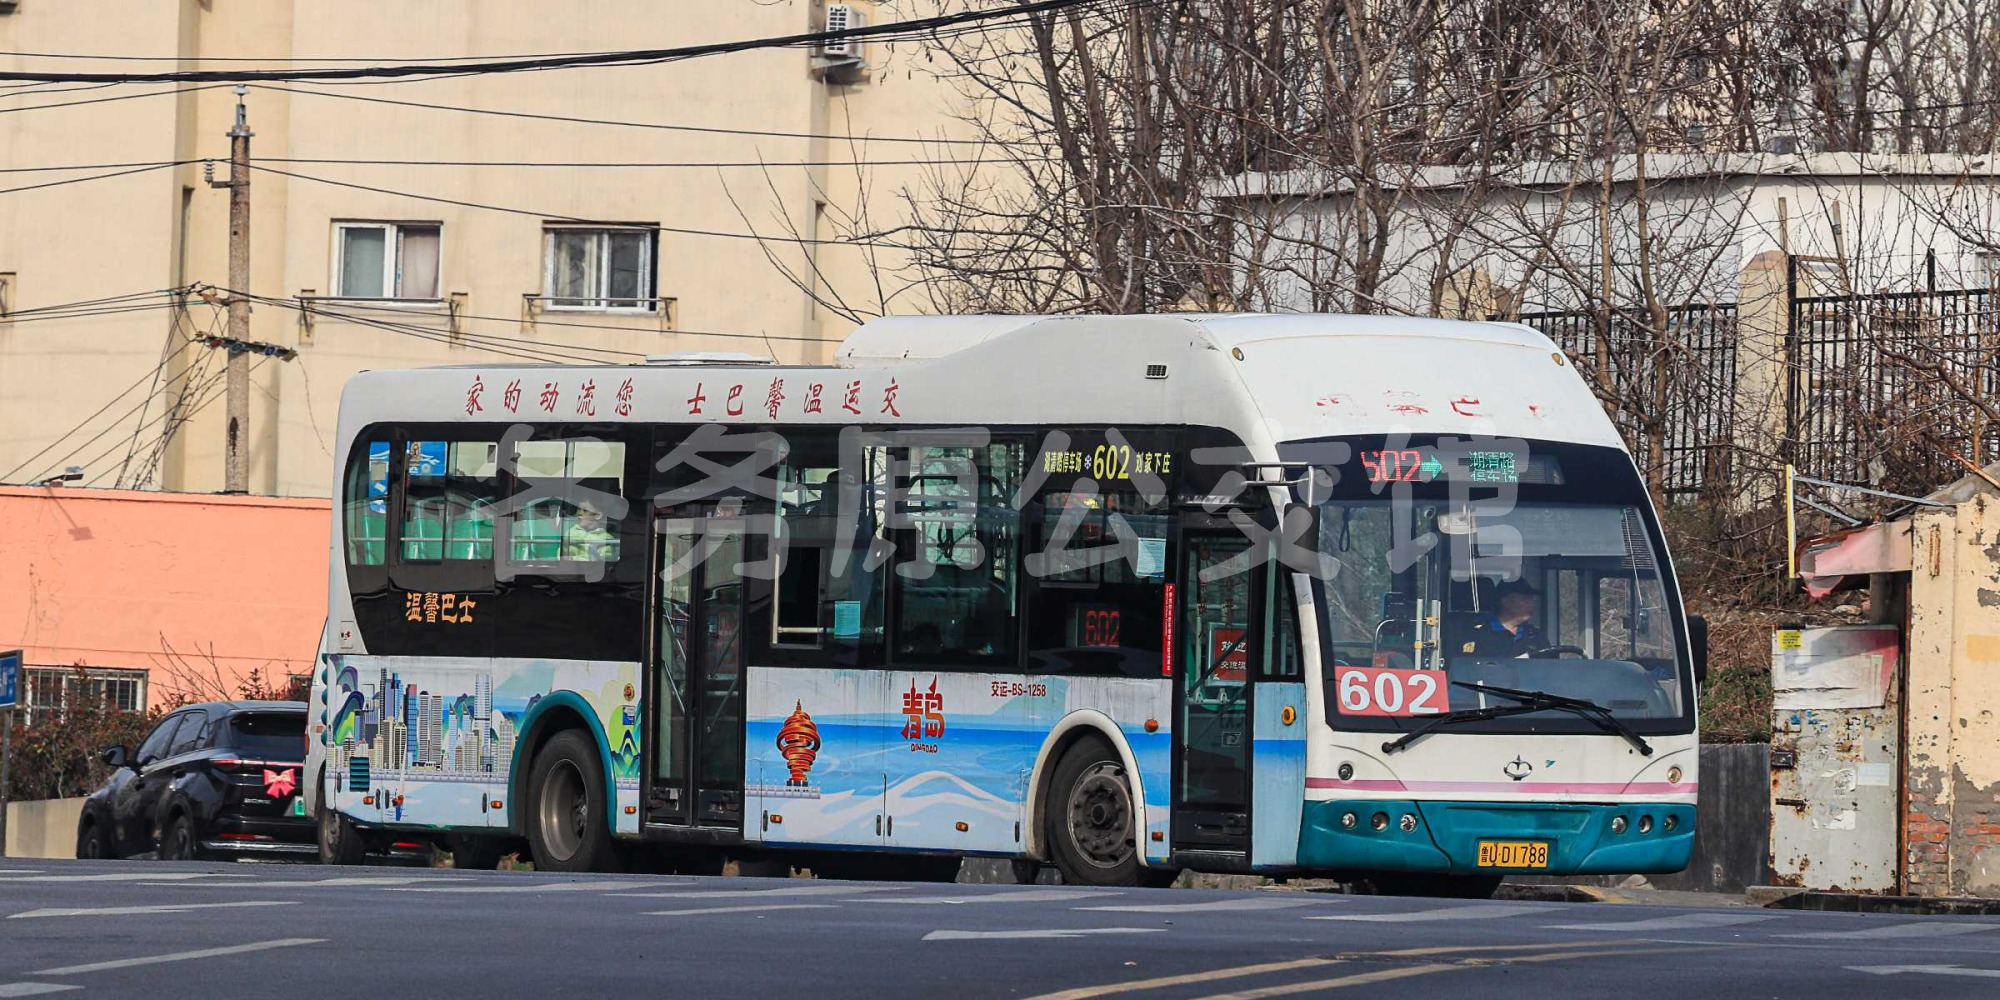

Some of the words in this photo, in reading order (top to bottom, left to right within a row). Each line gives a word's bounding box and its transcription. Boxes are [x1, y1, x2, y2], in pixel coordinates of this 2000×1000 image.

[1093, 444, 1130, 480] 602
[1135, 452, 1171, 474] 刘家下庄
[1085, 610, 1120, 647] 602
[901, 674, 945, 740] 青岛
[1340, 670, 1439, 713] 602
[911, 743, 938, 754] QINGDAO
